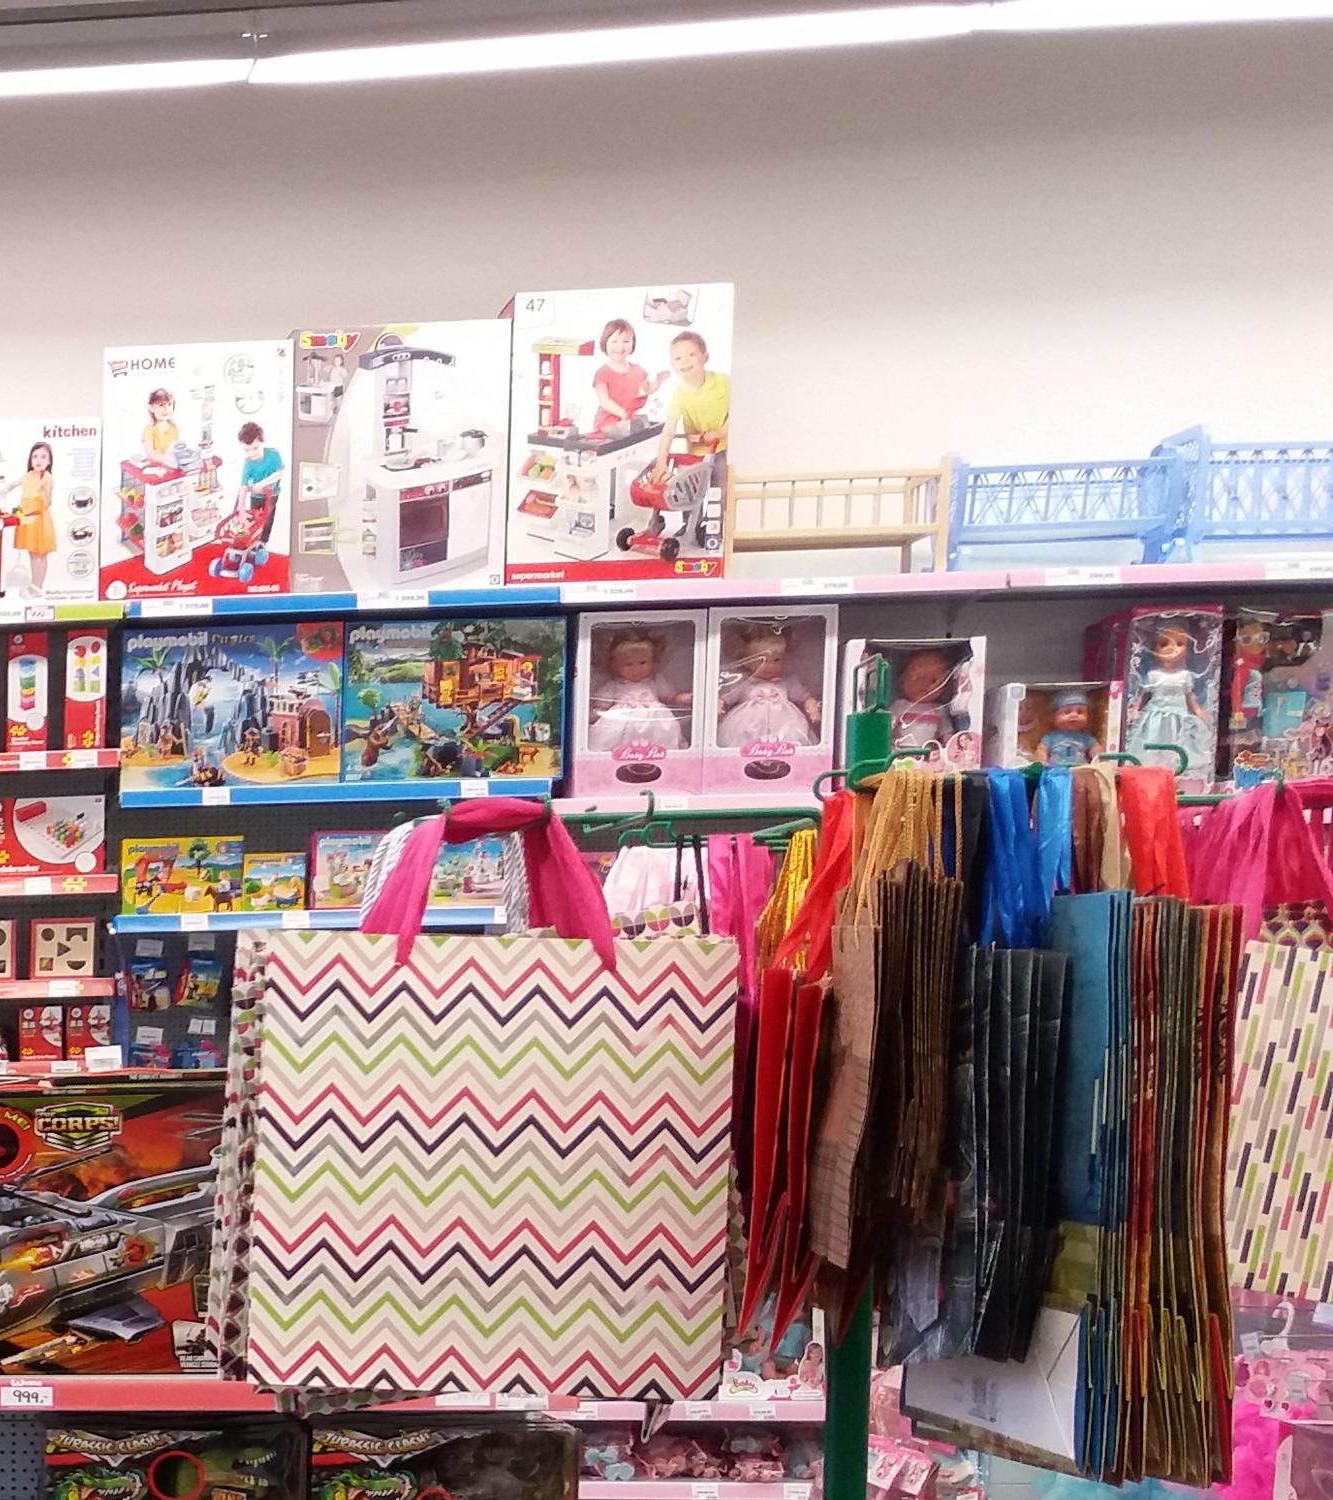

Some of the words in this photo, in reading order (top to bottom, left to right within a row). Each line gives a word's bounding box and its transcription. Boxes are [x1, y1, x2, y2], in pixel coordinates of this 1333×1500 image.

[526, 297, 545, 313] 47
[130, 356, 176, 371] HOME
[42, 424, 97, 439] kitchen
[126, 630, 209, 652] playmobil
[2, 1110, 30, 1132] ME!
[36, 1116, 121, 1135] CORPS!
